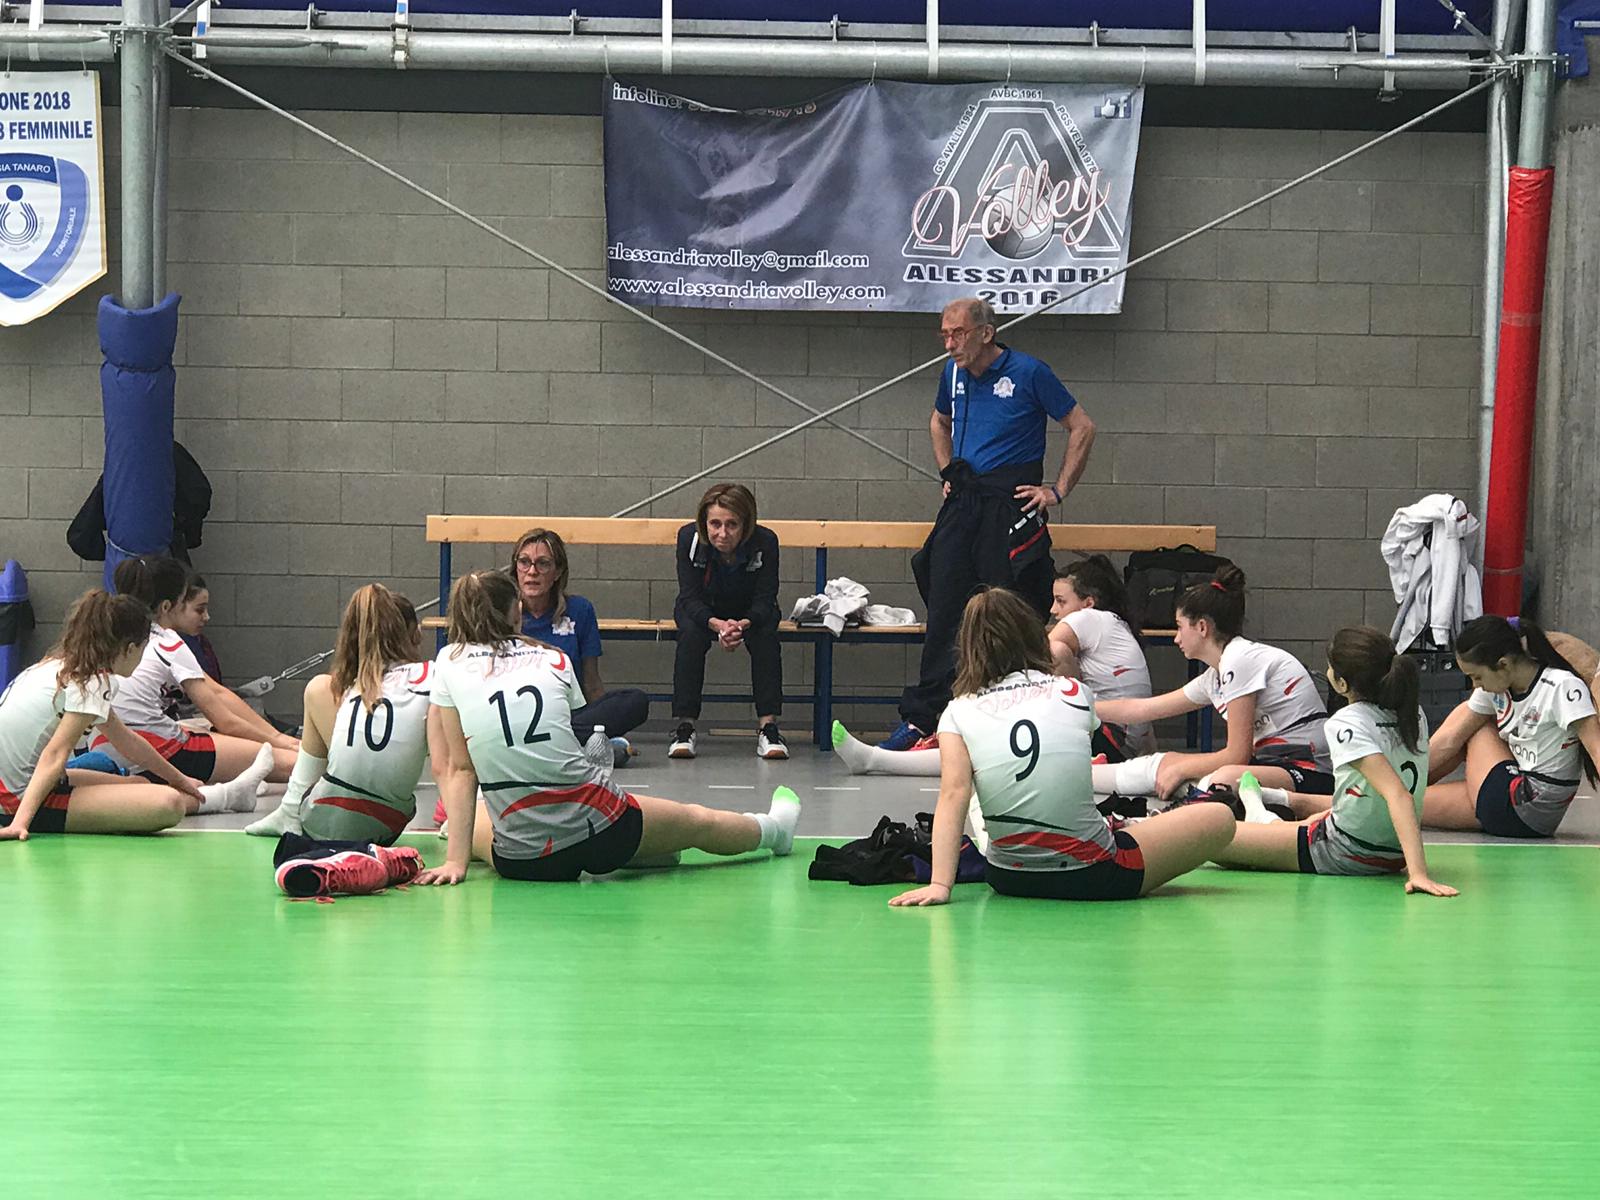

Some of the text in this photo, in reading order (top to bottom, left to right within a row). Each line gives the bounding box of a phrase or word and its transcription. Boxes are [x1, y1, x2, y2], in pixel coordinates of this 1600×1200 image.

[33, 91, 71, 111] 2018
[990, 89, 1042, 99] AVBC 1961
[9, 120, 93, 140] FEMMINILE
[934, 159, 947, 174] GS
[960, 105, 977, 126] 1984
[1057, 105, 1098, 174] PGS VELA 1978
[12, 163, 51, 174] TANARO
[912, 159, 1111, 257] Volley
[52, 207, 77, 258] TERRITORIALE
[608, 242, 869, 272] alessandriavolley@gmail.com
[905, 265, 1114, 285] ALESSANDRI
[608, 277, 886, 304] www.alessandriavolley.com
[979, 289, 1060, 307] 2016
[346, 695, 394, 751] 10
[488, 684, 551, 748] 12
[1009, 718, 1041, 782] 9
